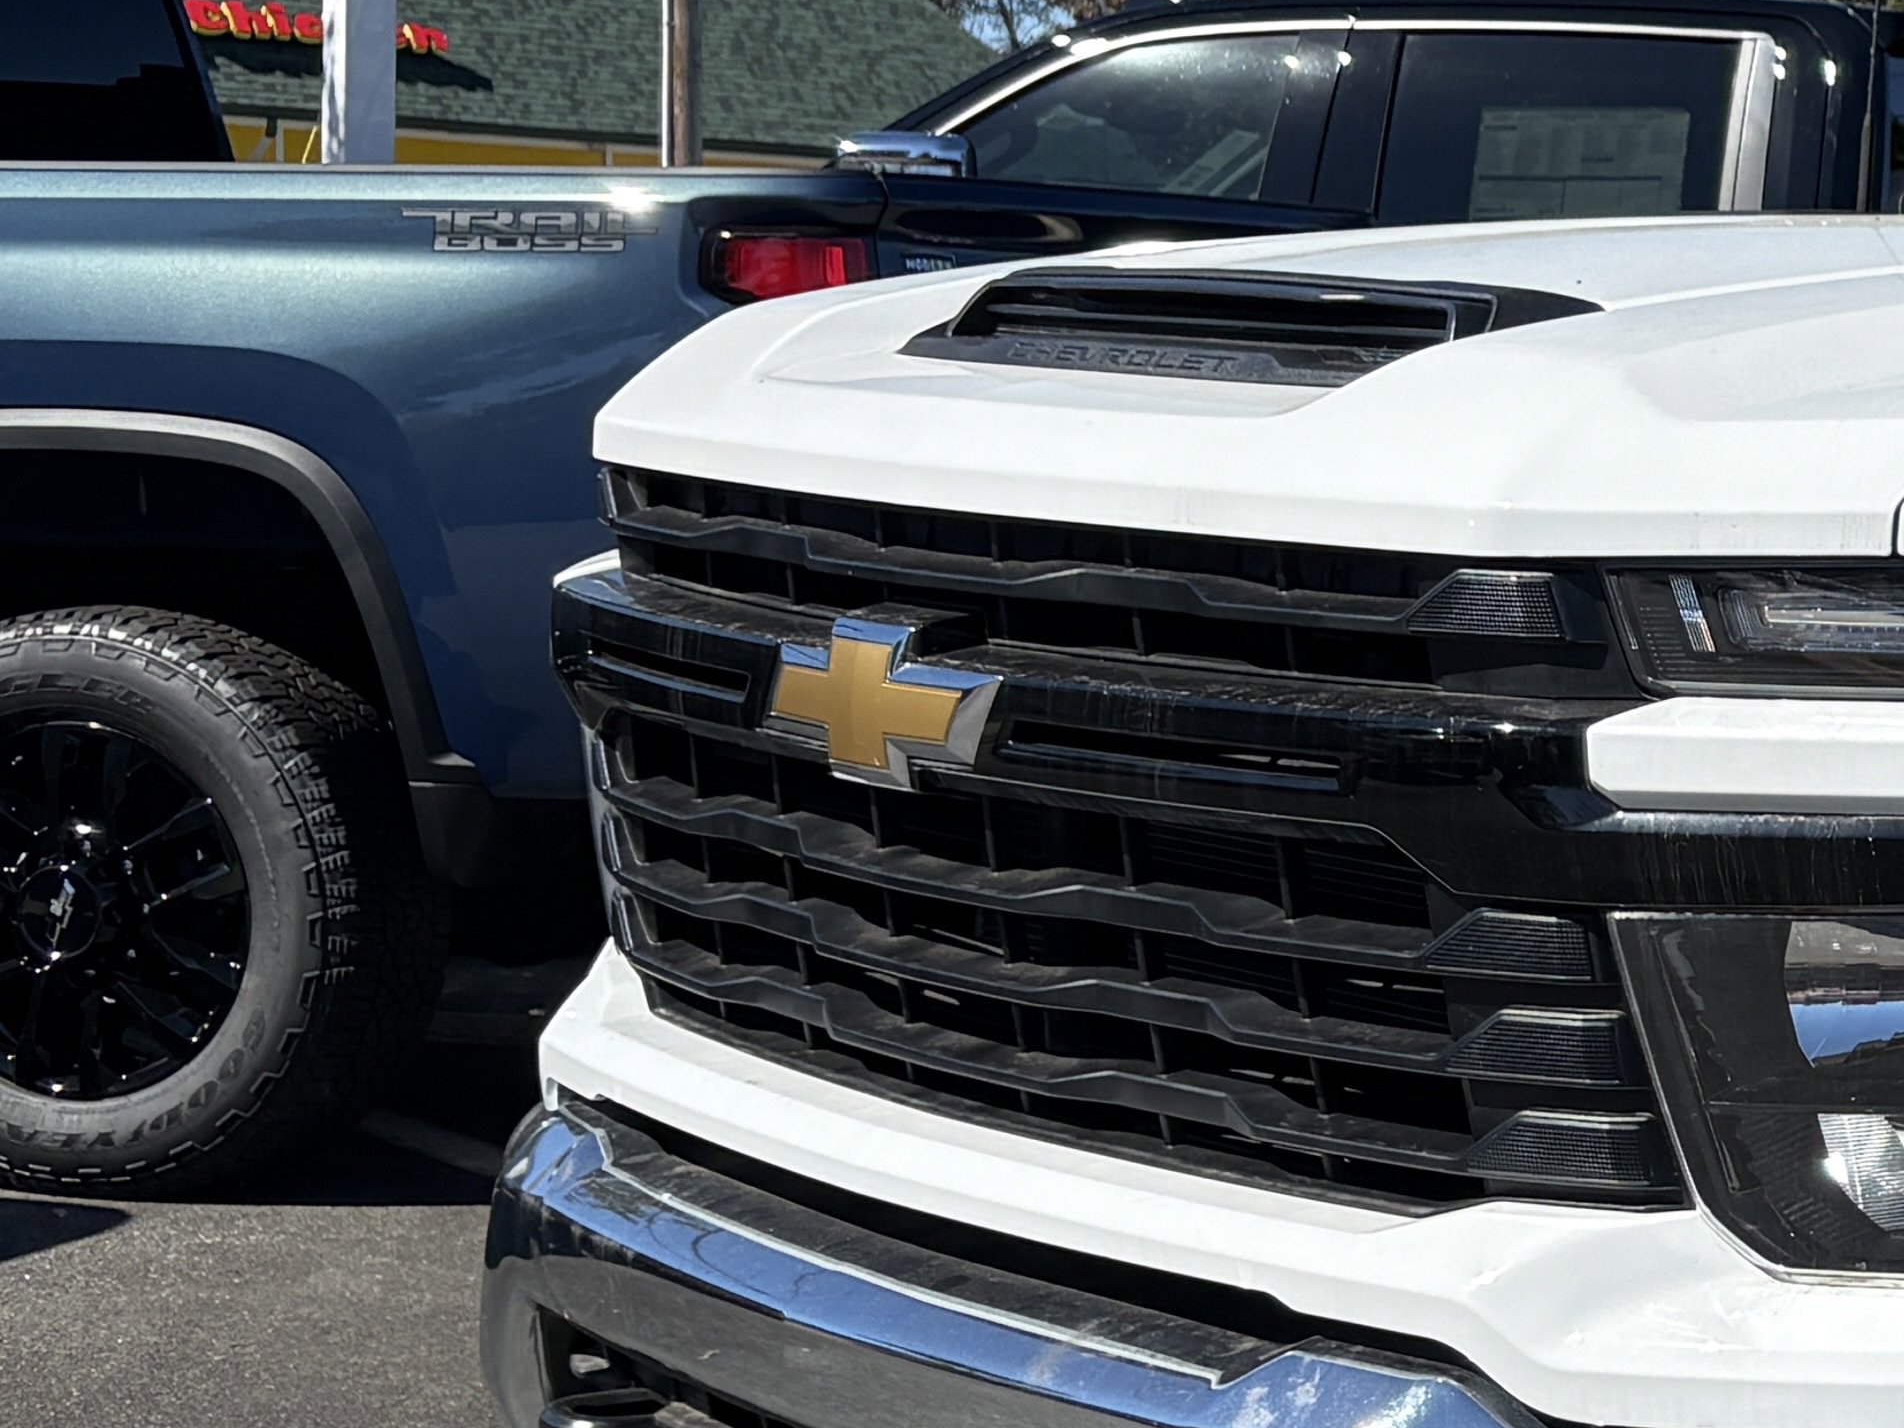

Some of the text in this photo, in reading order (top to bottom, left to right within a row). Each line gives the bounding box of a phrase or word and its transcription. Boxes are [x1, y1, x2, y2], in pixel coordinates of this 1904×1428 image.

[402, 208, 657, 235] TRAIL
[433, 234, 625, 252] BOSS
[1006, 340, 1238, 373] CHEVROLET
